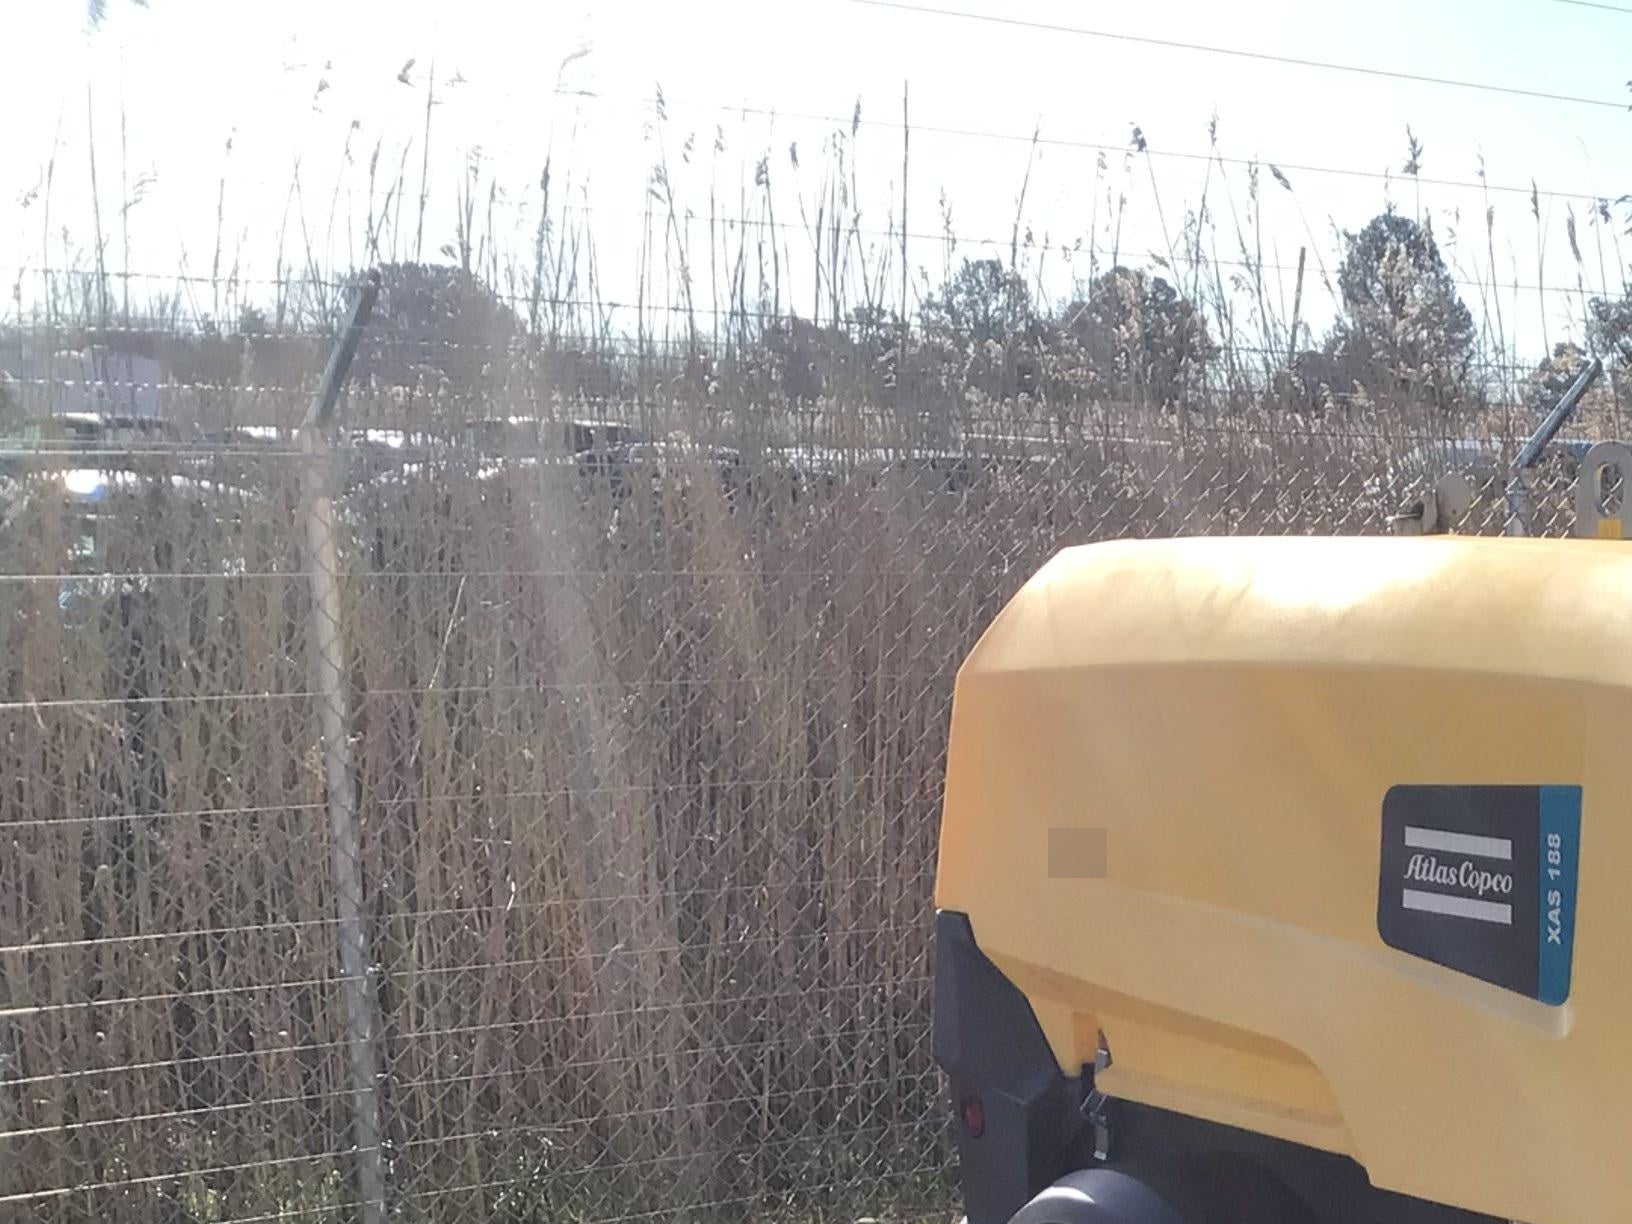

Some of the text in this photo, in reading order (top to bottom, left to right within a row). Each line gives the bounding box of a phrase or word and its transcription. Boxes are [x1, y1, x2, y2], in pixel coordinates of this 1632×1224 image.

[1403, 854, 1513, 896] Atlas Copco
[1547, 833, 1562, 945] XAS 188
